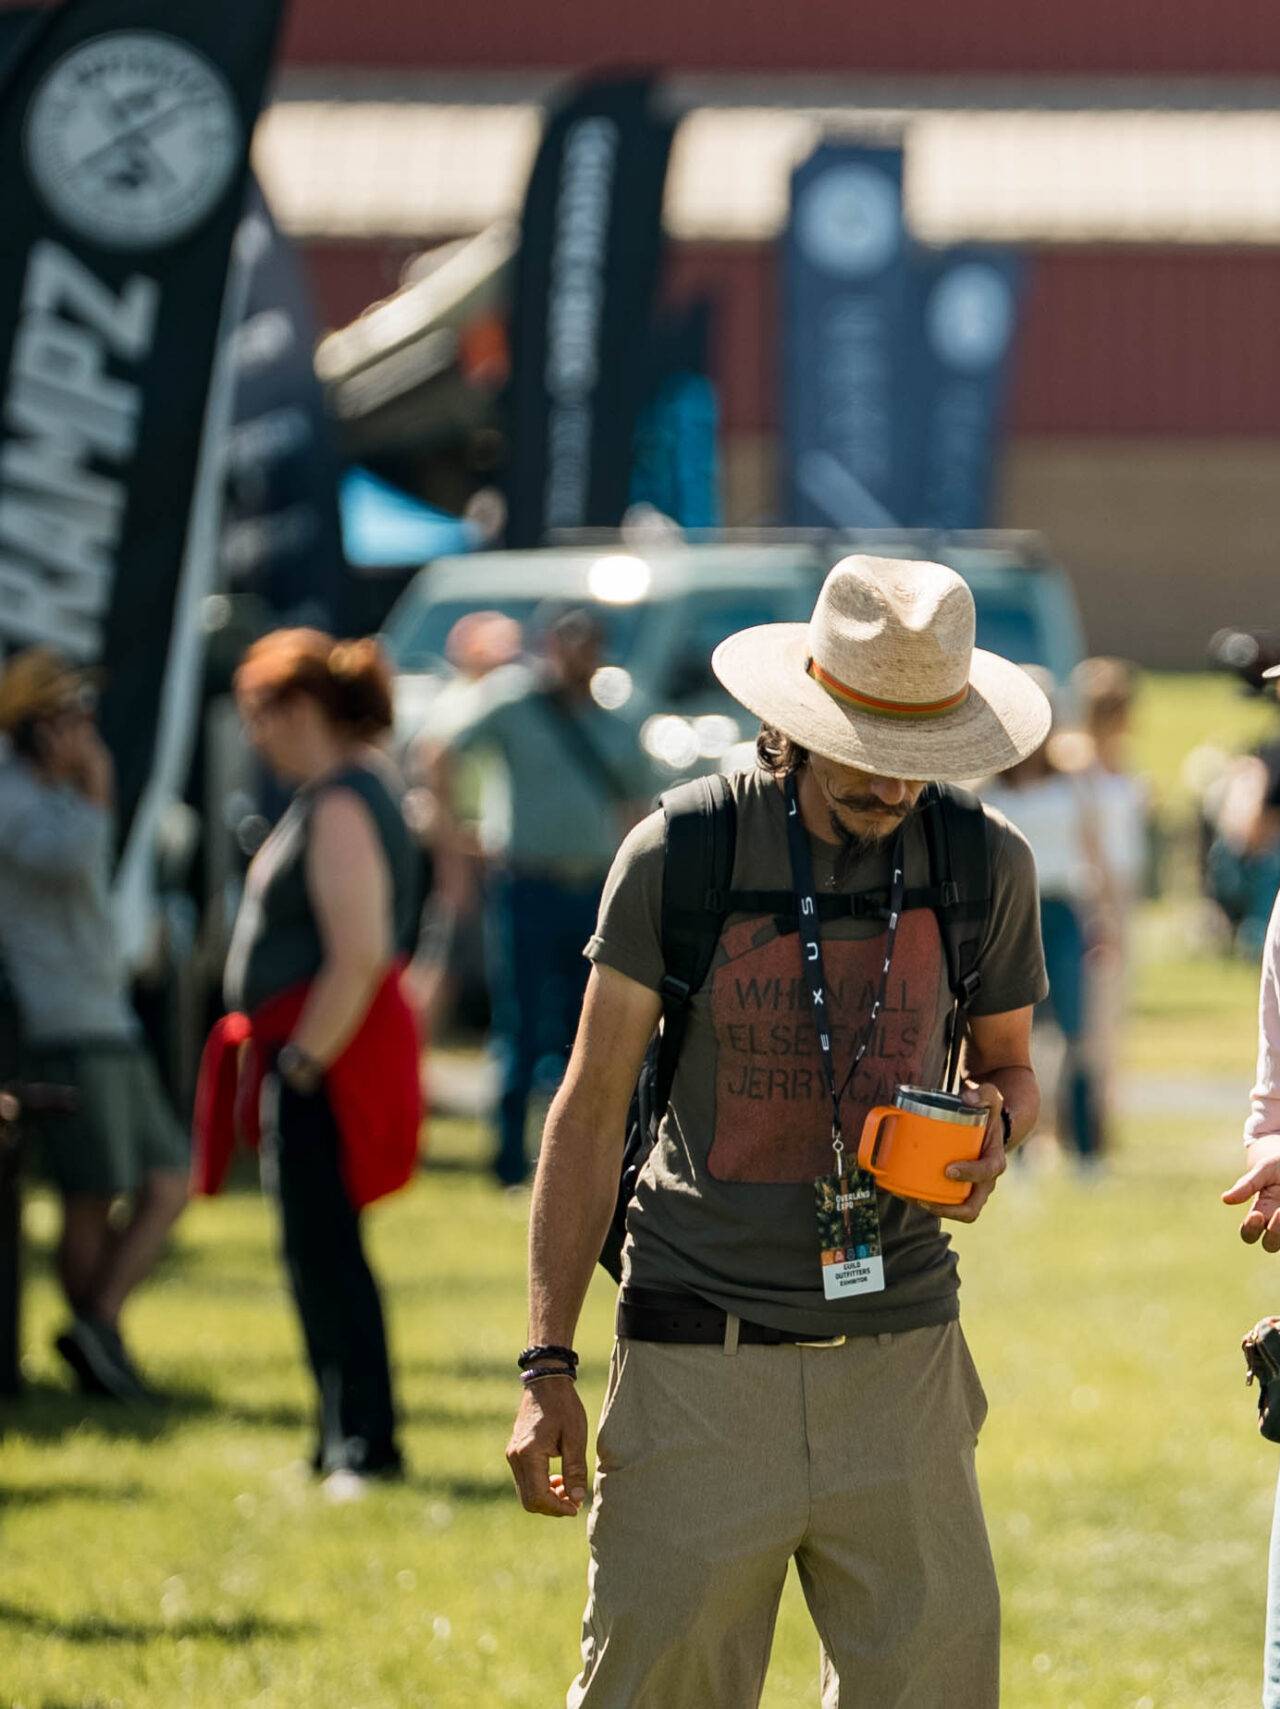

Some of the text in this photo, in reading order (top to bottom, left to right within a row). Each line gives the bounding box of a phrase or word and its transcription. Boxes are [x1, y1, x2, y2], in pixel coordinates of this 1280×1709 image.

[733, 977, 845, 1011] WHN
[727, 1023, 813, 1057] ELSE
[835, 1190, 871, 1203] OVERLAND
[836, 1200, 854, 1212] EXPO
[834, 1267, 871, 1280] OUTFITTERS
